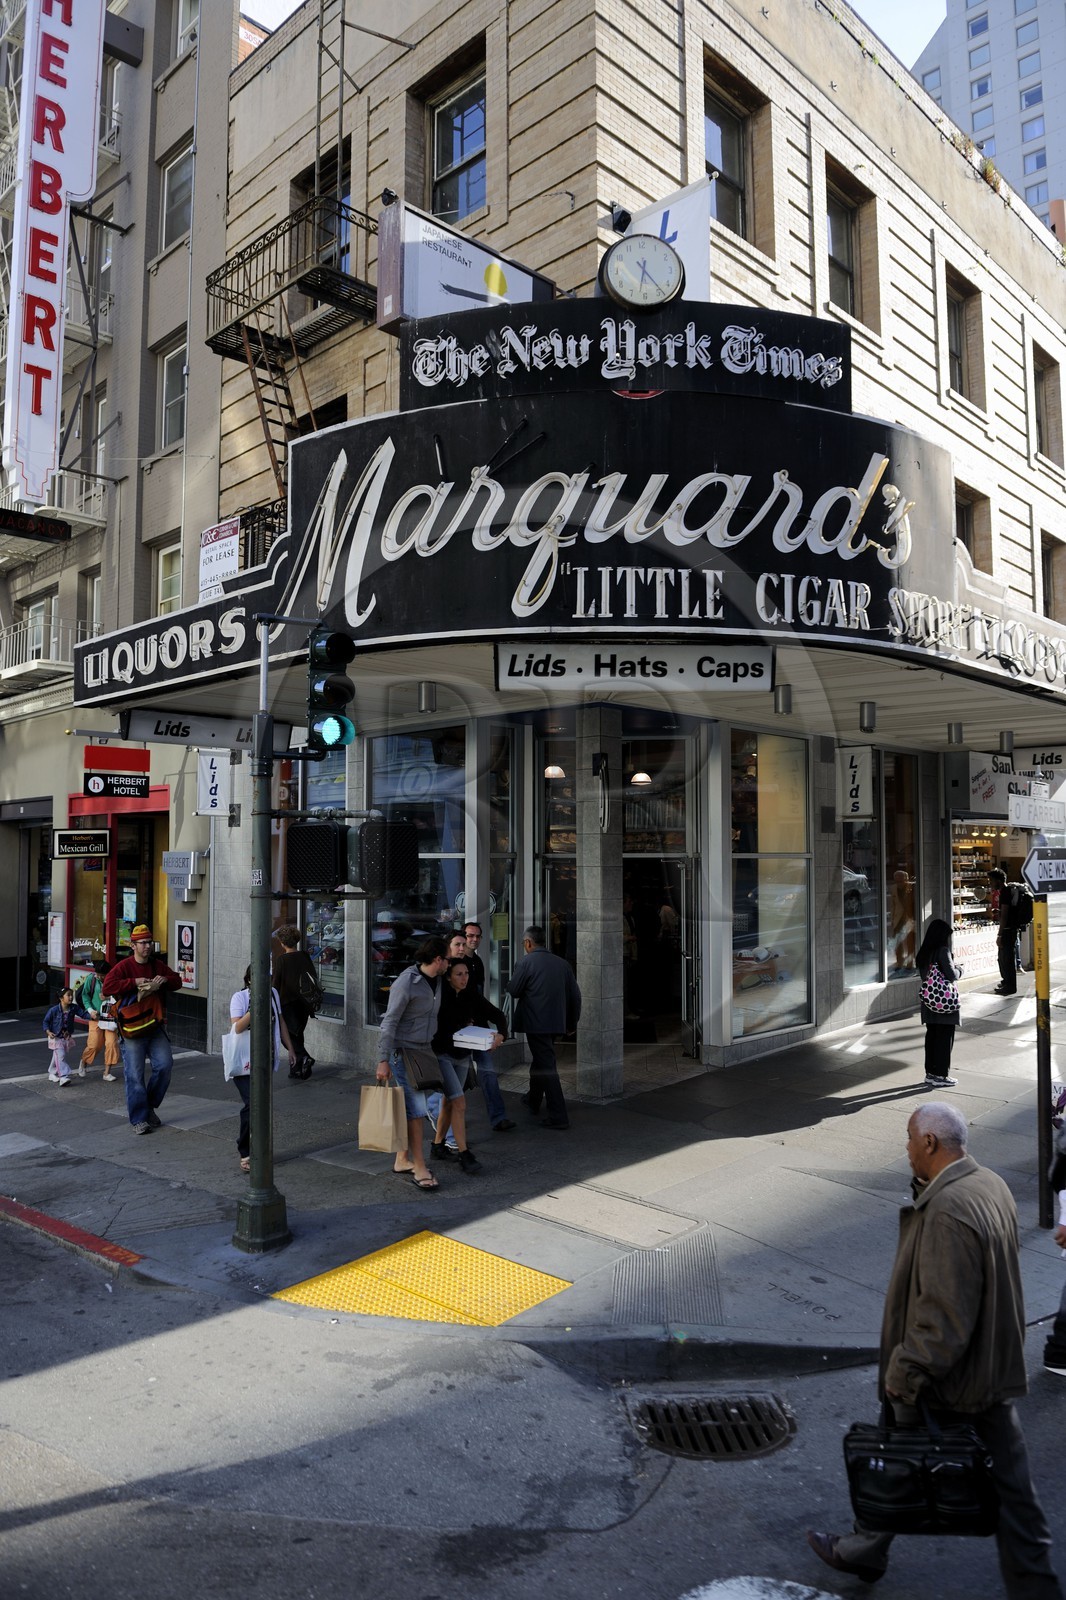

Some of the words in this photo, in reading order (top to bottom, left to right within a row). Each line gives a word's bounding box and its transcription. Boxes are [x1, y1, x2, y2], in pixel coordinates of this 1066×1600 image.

[422, 224, 463, 250] JAPANESE
[421, 236, 473, 269] RESTAURANT
[412, 329, 491, 388] The
[496, 324, 594, 380] New
[599, 317, 714, 382] York
[720, 324, 843, 390] Times
[256, 435, 915, 645] Marquard's
[202, 555, 214, 567] FOR
[215, 547, 235, 561] LEASE
[755, 572, 872, 631] CIGAR
[83, 607, 247, 688] LIQUORS
[507, 653, 567, 678] Lids
[593, 653, 669, 678] Hats
[696, 654, 765, 683] Caps
[153, 719, 191, 738] Lids
[992, 755, 1011, 775] San
[1032, 752, 1063, 766] Lids
[107, 776, 147, 786] HERBERT
[113, 786, 141, 796] HOTEL
[209, 757, 219, 809] Lids
[848, 755, 860, 813] Lids
[59, 844, 88, 853] Mexican
[88, 843, 104, 852] Grill
[163, 857, 190, 869] HERBERT
[1037, 861, 1053, 879] ONE
[170, 876, 185, 886] HOTEL
